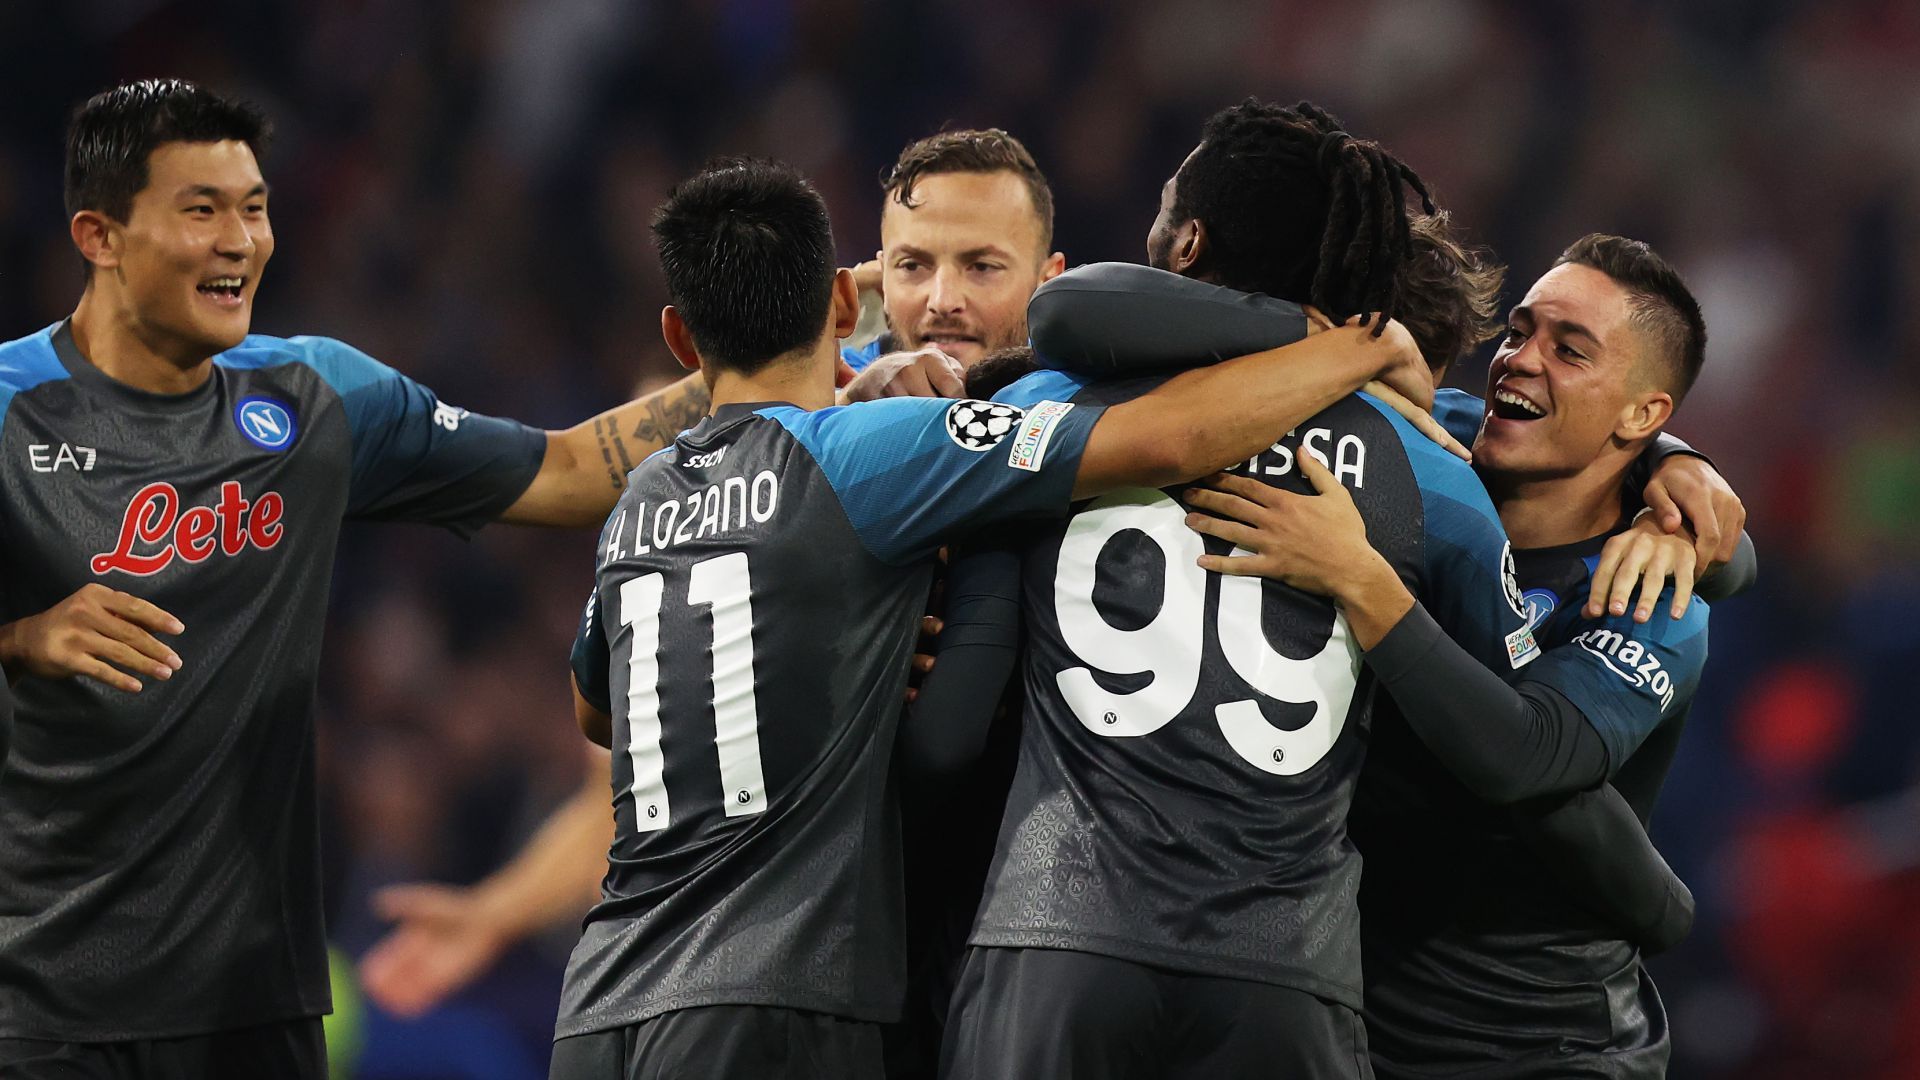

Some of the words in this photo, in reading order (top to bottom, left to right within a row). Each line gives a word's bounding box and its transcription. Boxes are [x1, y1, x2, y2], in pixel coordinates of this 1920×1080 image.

[28, 443, 96, 472] EA7
[247, 408, 281, 438] N
[683, 446, 727, 469] SSCN
[90, 480, 284, 577] Lete
[634, 470, 778, 556] LOZANO
[1054, 488, 1358, 776] 99
[1571, 629, 1675, 713] amazon
[620, 552, 767, 832] 11
